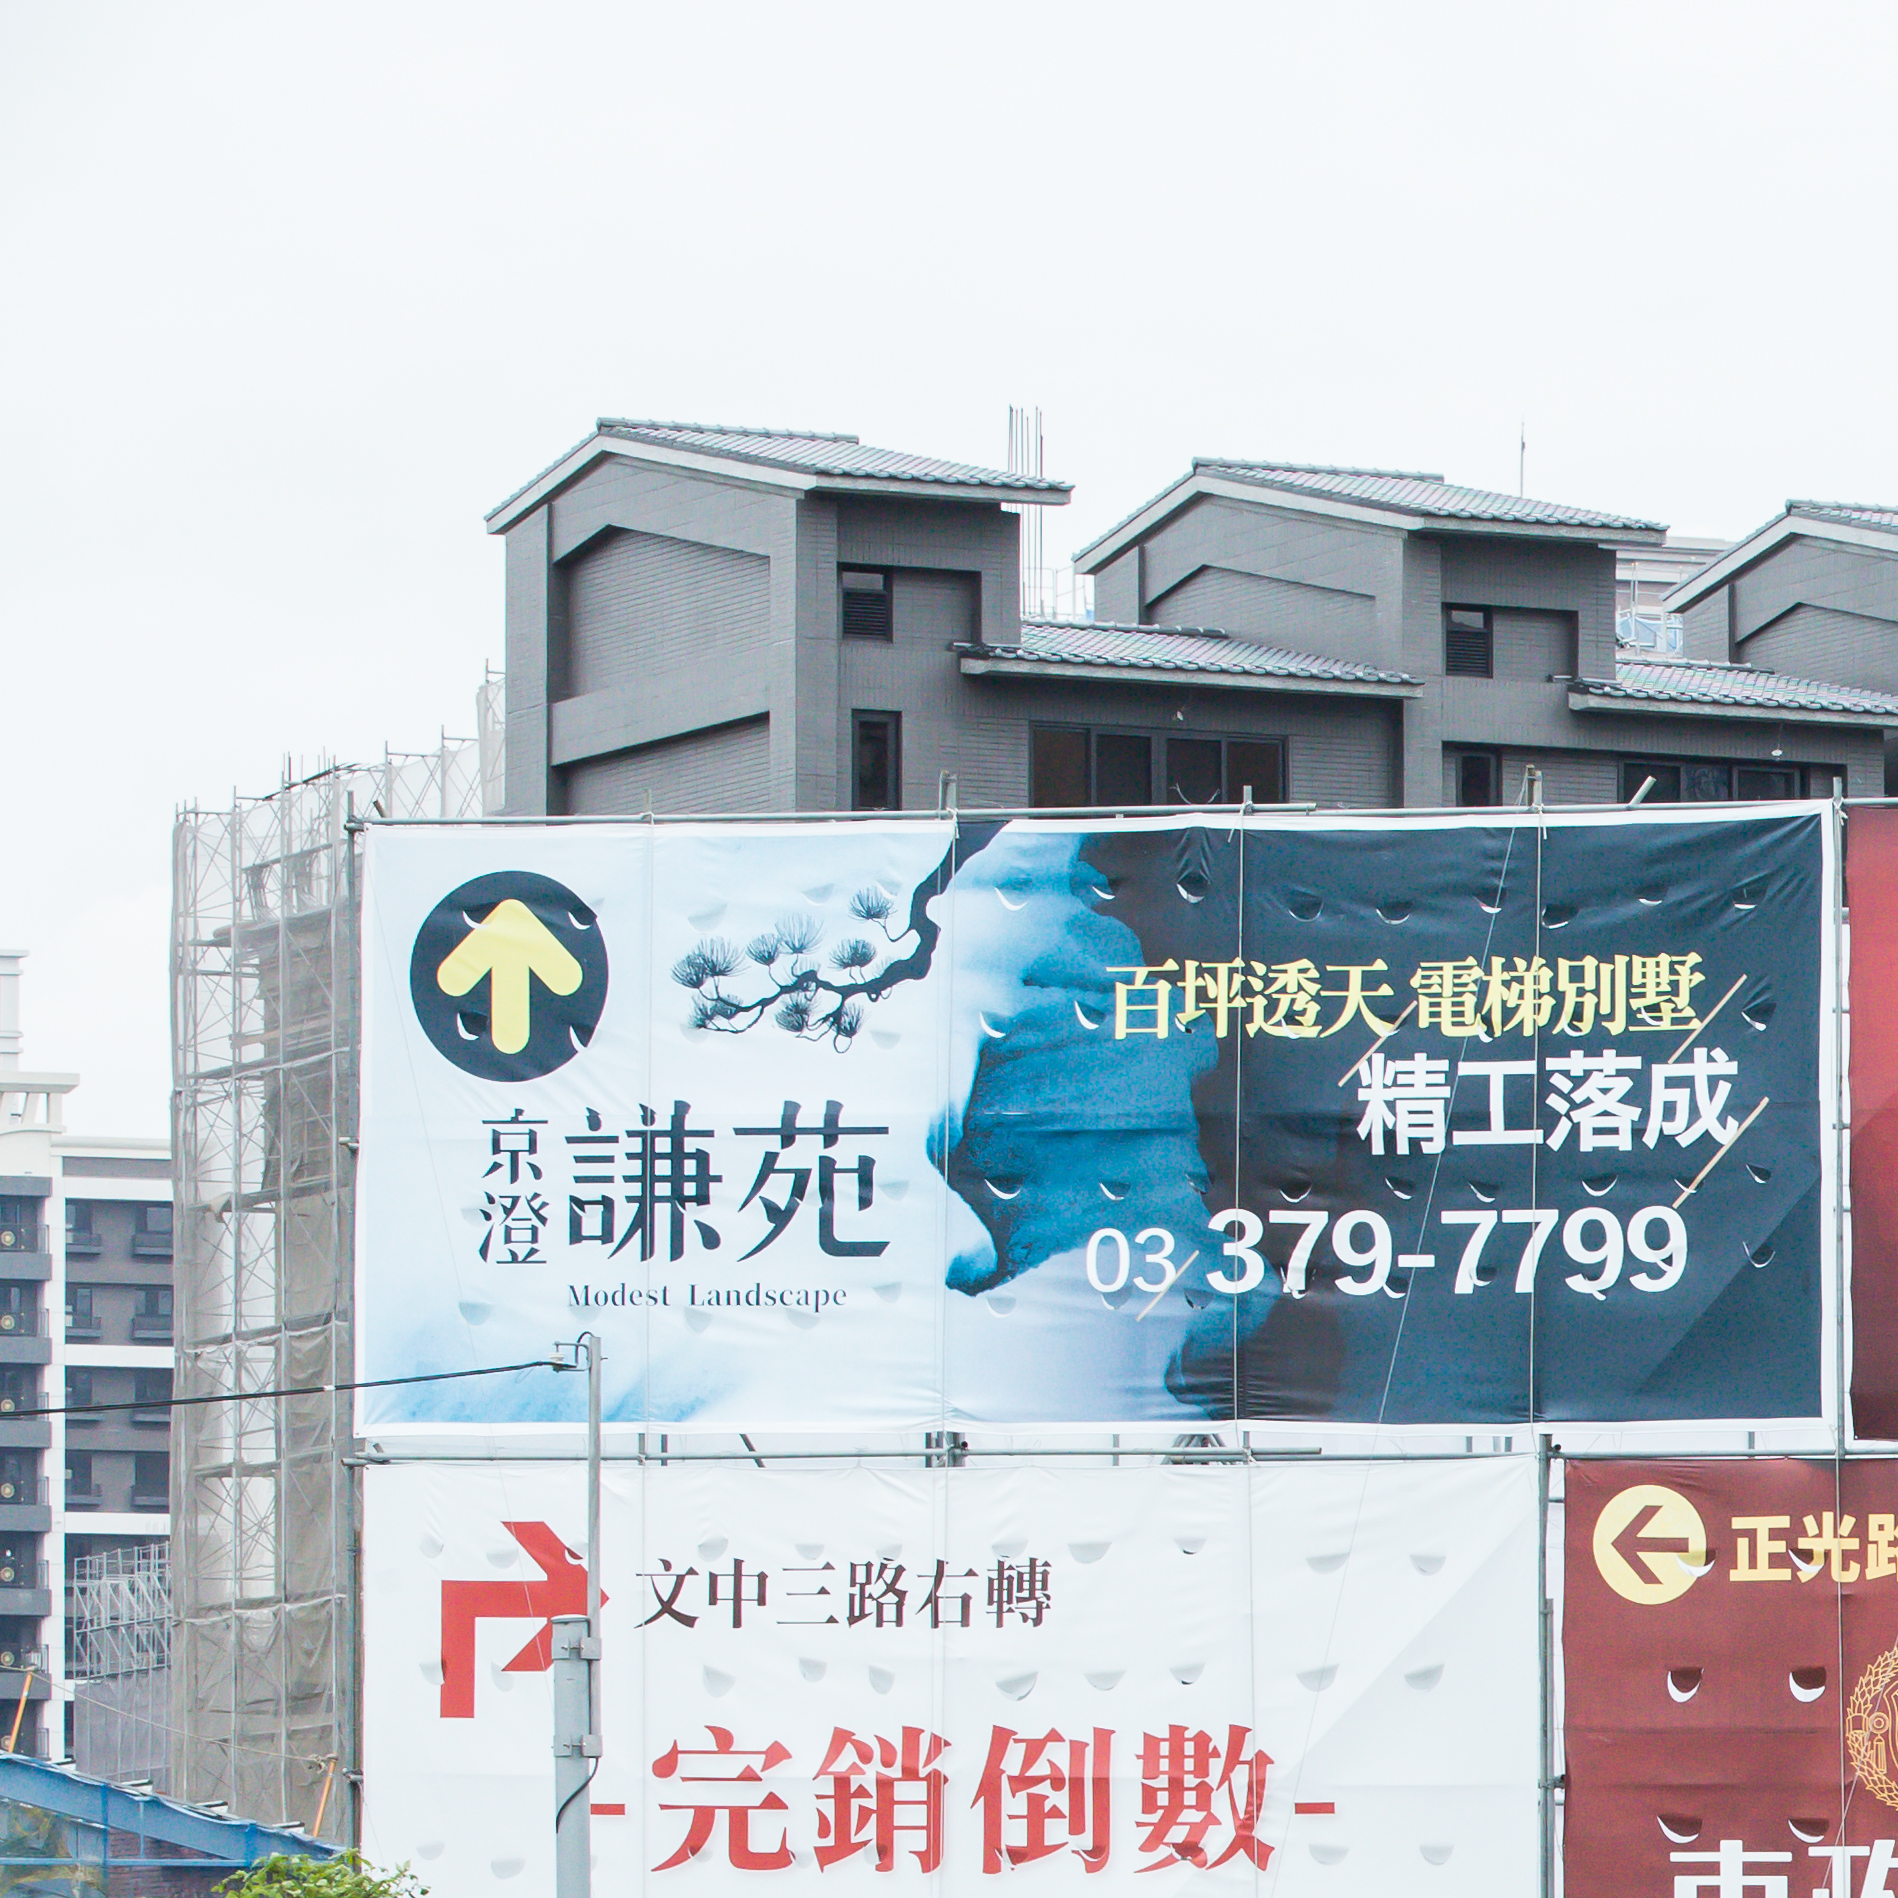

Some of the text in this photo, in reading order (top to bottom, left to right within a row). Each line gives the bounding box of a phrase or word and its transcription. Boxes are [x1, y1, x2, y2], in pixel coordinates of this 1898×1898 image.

[1106, 950, 1706, 1041] 百坪透天 電梯別墅
[1356, 1046, 1741, 1157] 精工落成
[477, 1107, 549, 1265] 京澄
[564, 1099, 891, 1264] 謙苑
[566, 1281, 848, 1313] Modest Landscape
[1205, 1204, 1690, 1299] 379-7799
[633, 1557, 1054, 1631] 文中三路右轉
